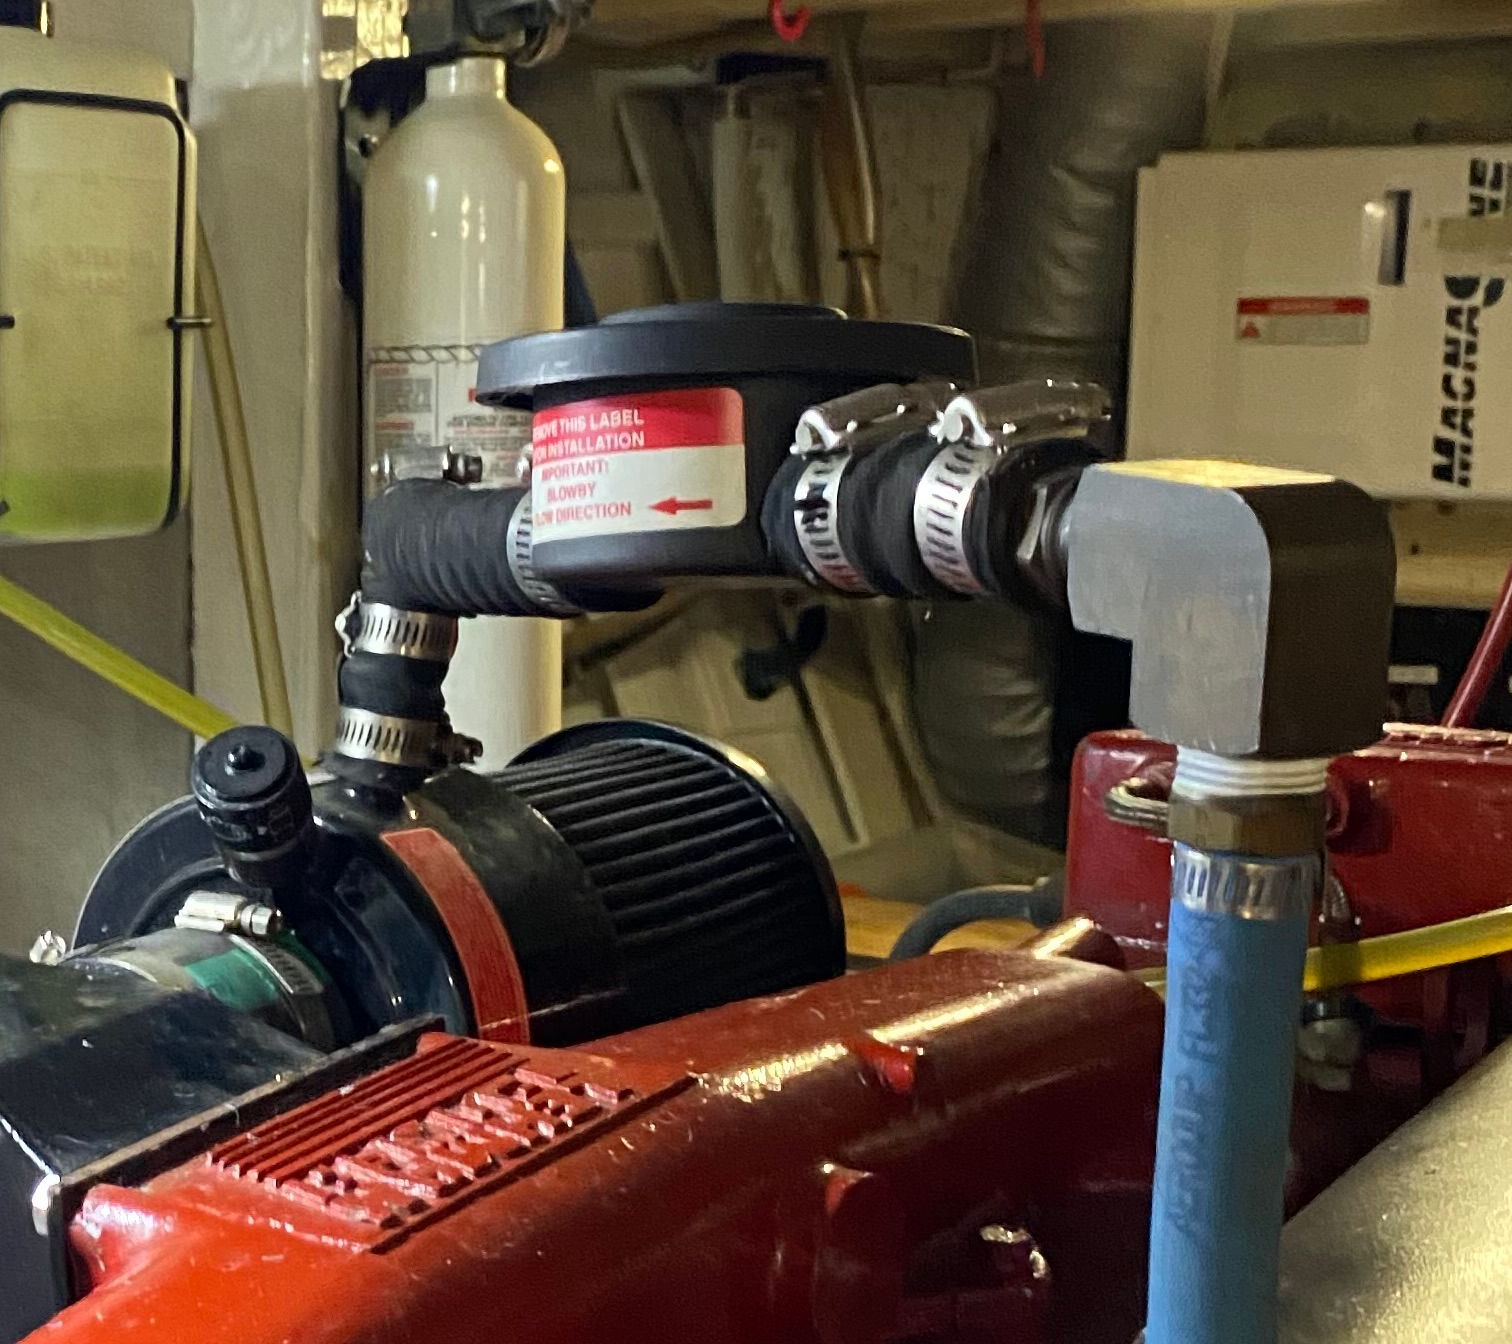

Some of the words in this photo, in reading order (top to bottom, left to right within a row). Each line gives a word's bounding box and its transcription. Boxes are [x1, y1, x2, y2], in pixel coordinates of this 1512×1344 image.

[559, 415, 586, 433] THIS
[589, 409, 644, 430] LABEL
[547, 431, 644, 457] INSTALLATION
[556, 501, 632, 525] DIRECTION
